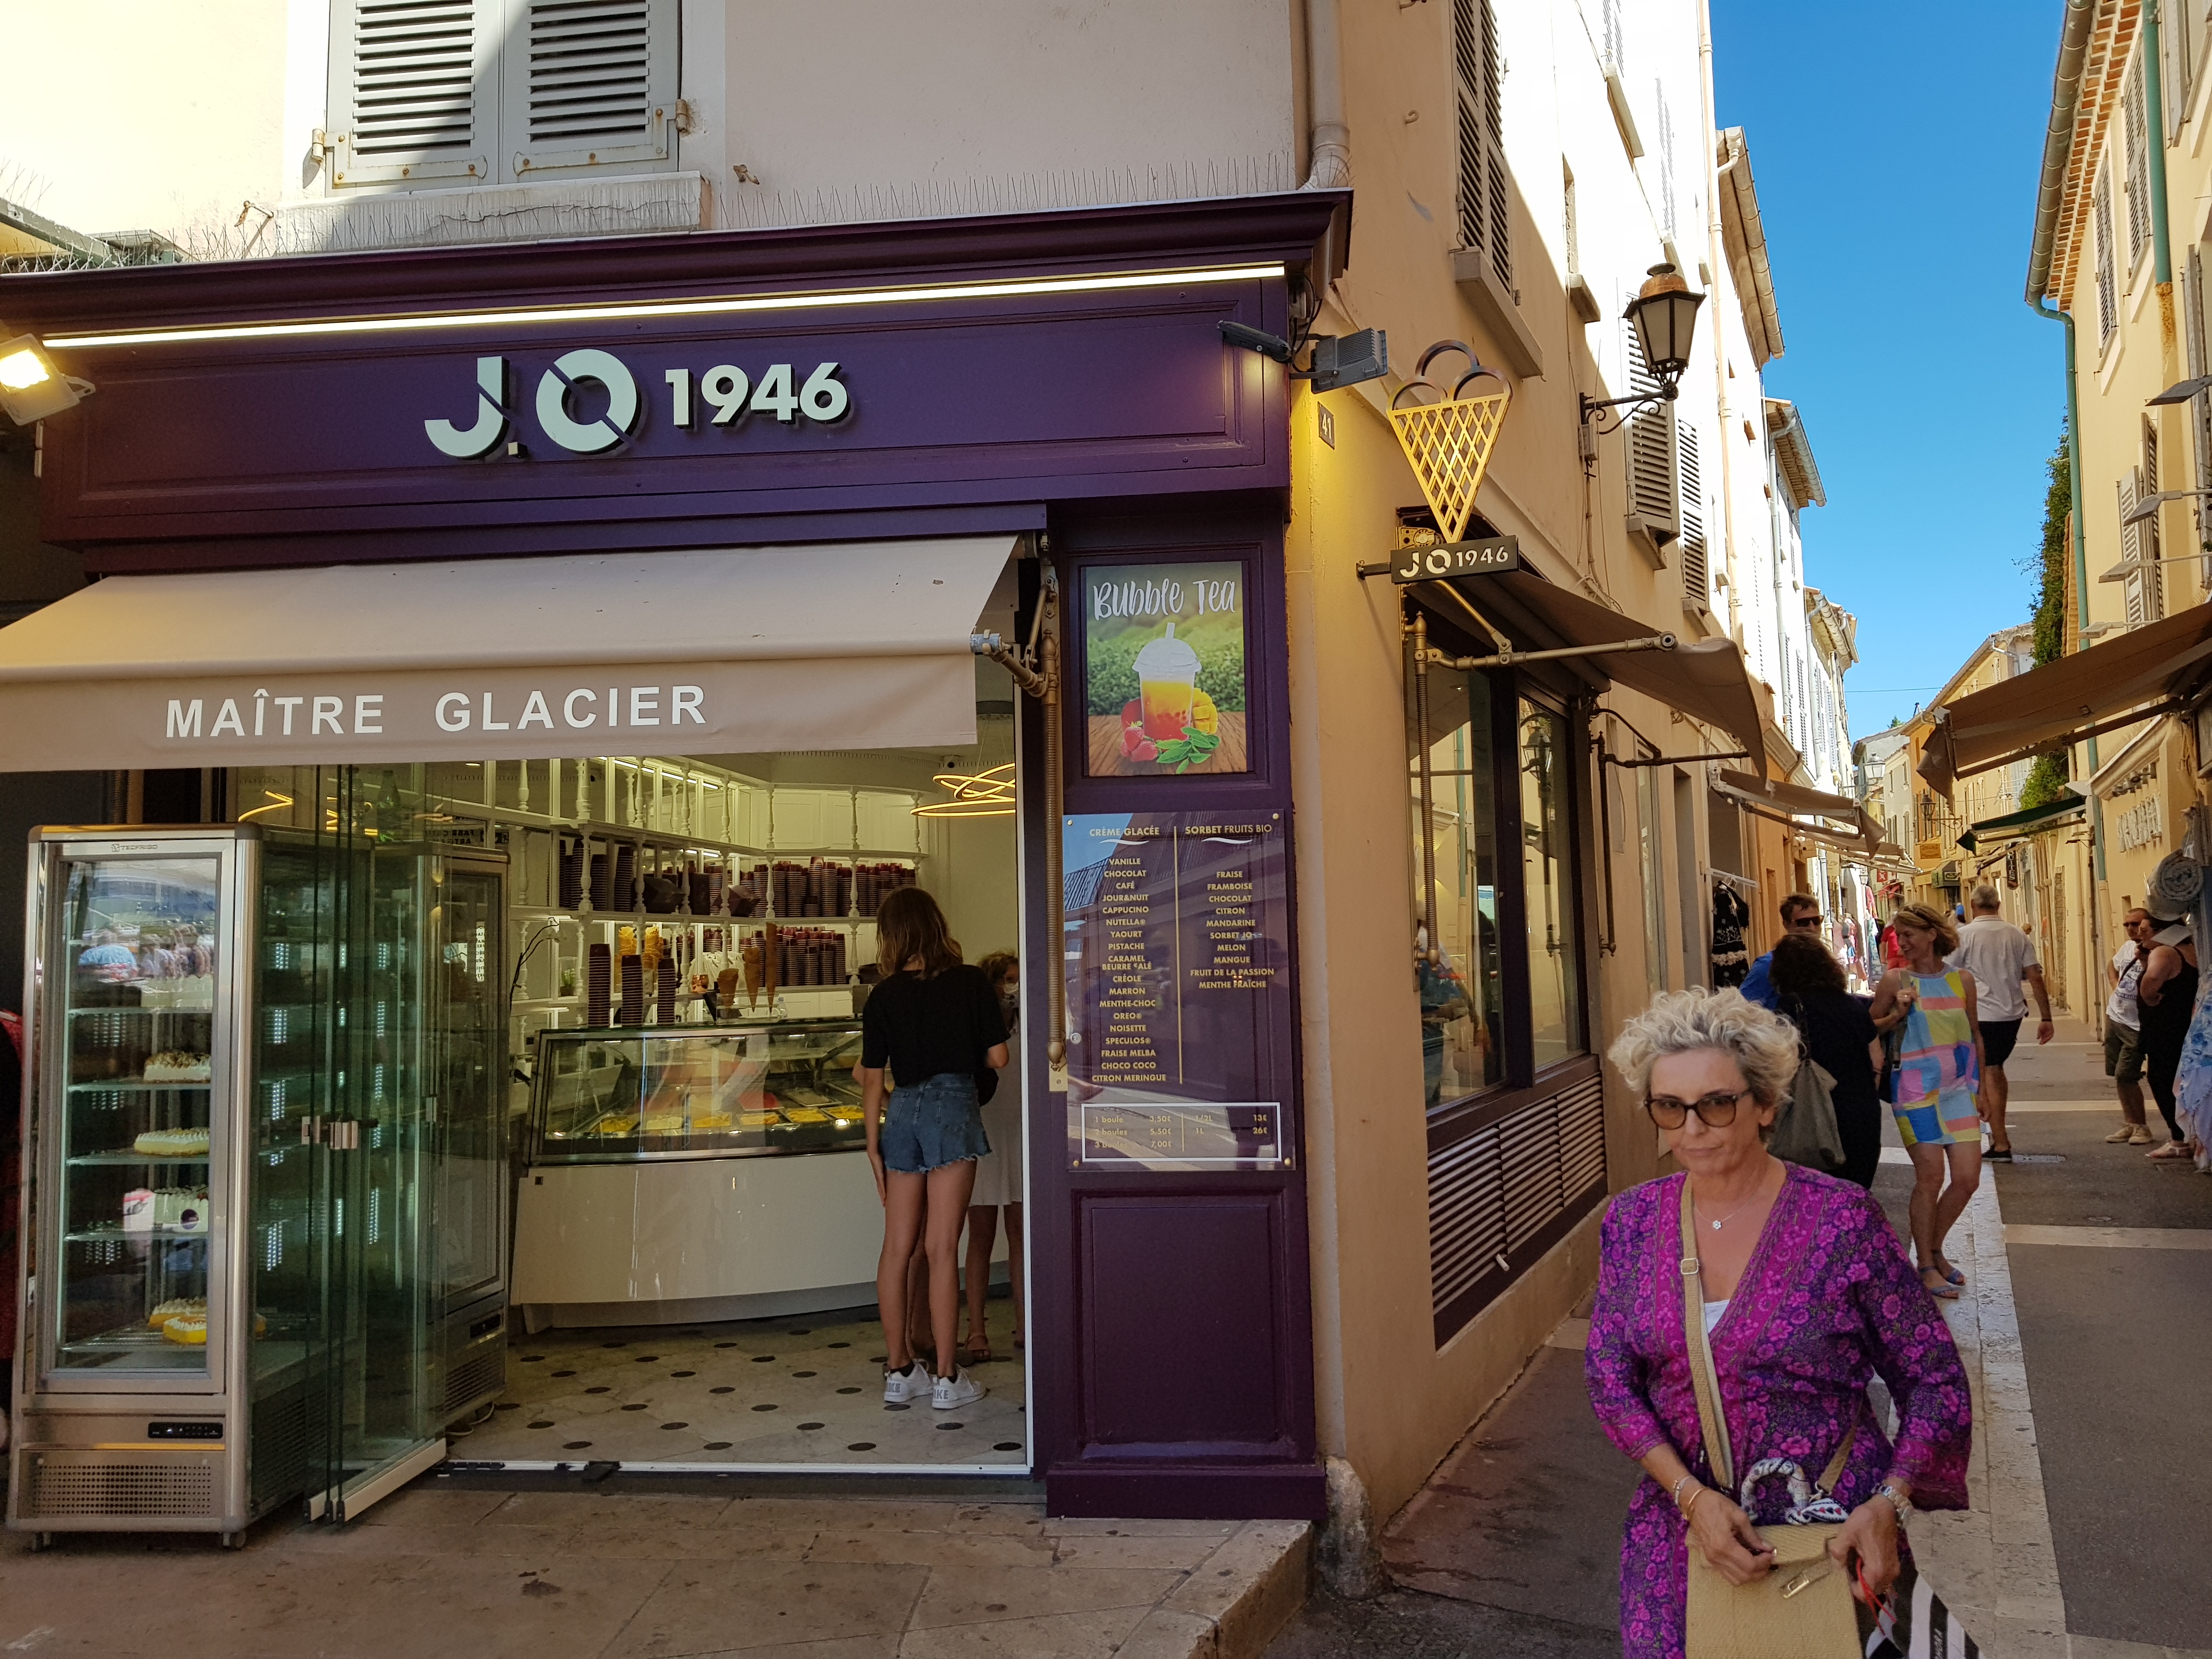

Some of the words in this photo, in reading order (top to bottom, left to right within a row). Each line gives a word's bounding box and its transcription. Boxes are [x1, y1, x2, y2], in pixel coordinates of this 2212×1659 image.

[665, 362, 847, 426] 1946
[1321, 413, 1332, 439] 41
[1456, 545, 1509, 567] 1946
[1093, 578, 1184, 620] Bubble
[1193, 579, 1235, 615] Tea
[166, 687, 383, 738] MAÎTRE
[435, 684, 706, 732] GLACIER
[1090, 826, 1120, 836] CRÈME
[1124, 825, 1160, 836] GLACÉE
[1185, 826, 1222, 834] SORBET
[1224, 825, 1254, 833] FRUITS
[1256, 824, 1272, 833] BIO
[1116, 881, 1135, 889] CAFÉ
[1113, 974, 1141, 983] CRÉOLE
[1233, 979, 1266, 988] FRAÎCHE
[887, 1383, 901, 1393] IKE
[934, 1389, 949, 1400] IKE
